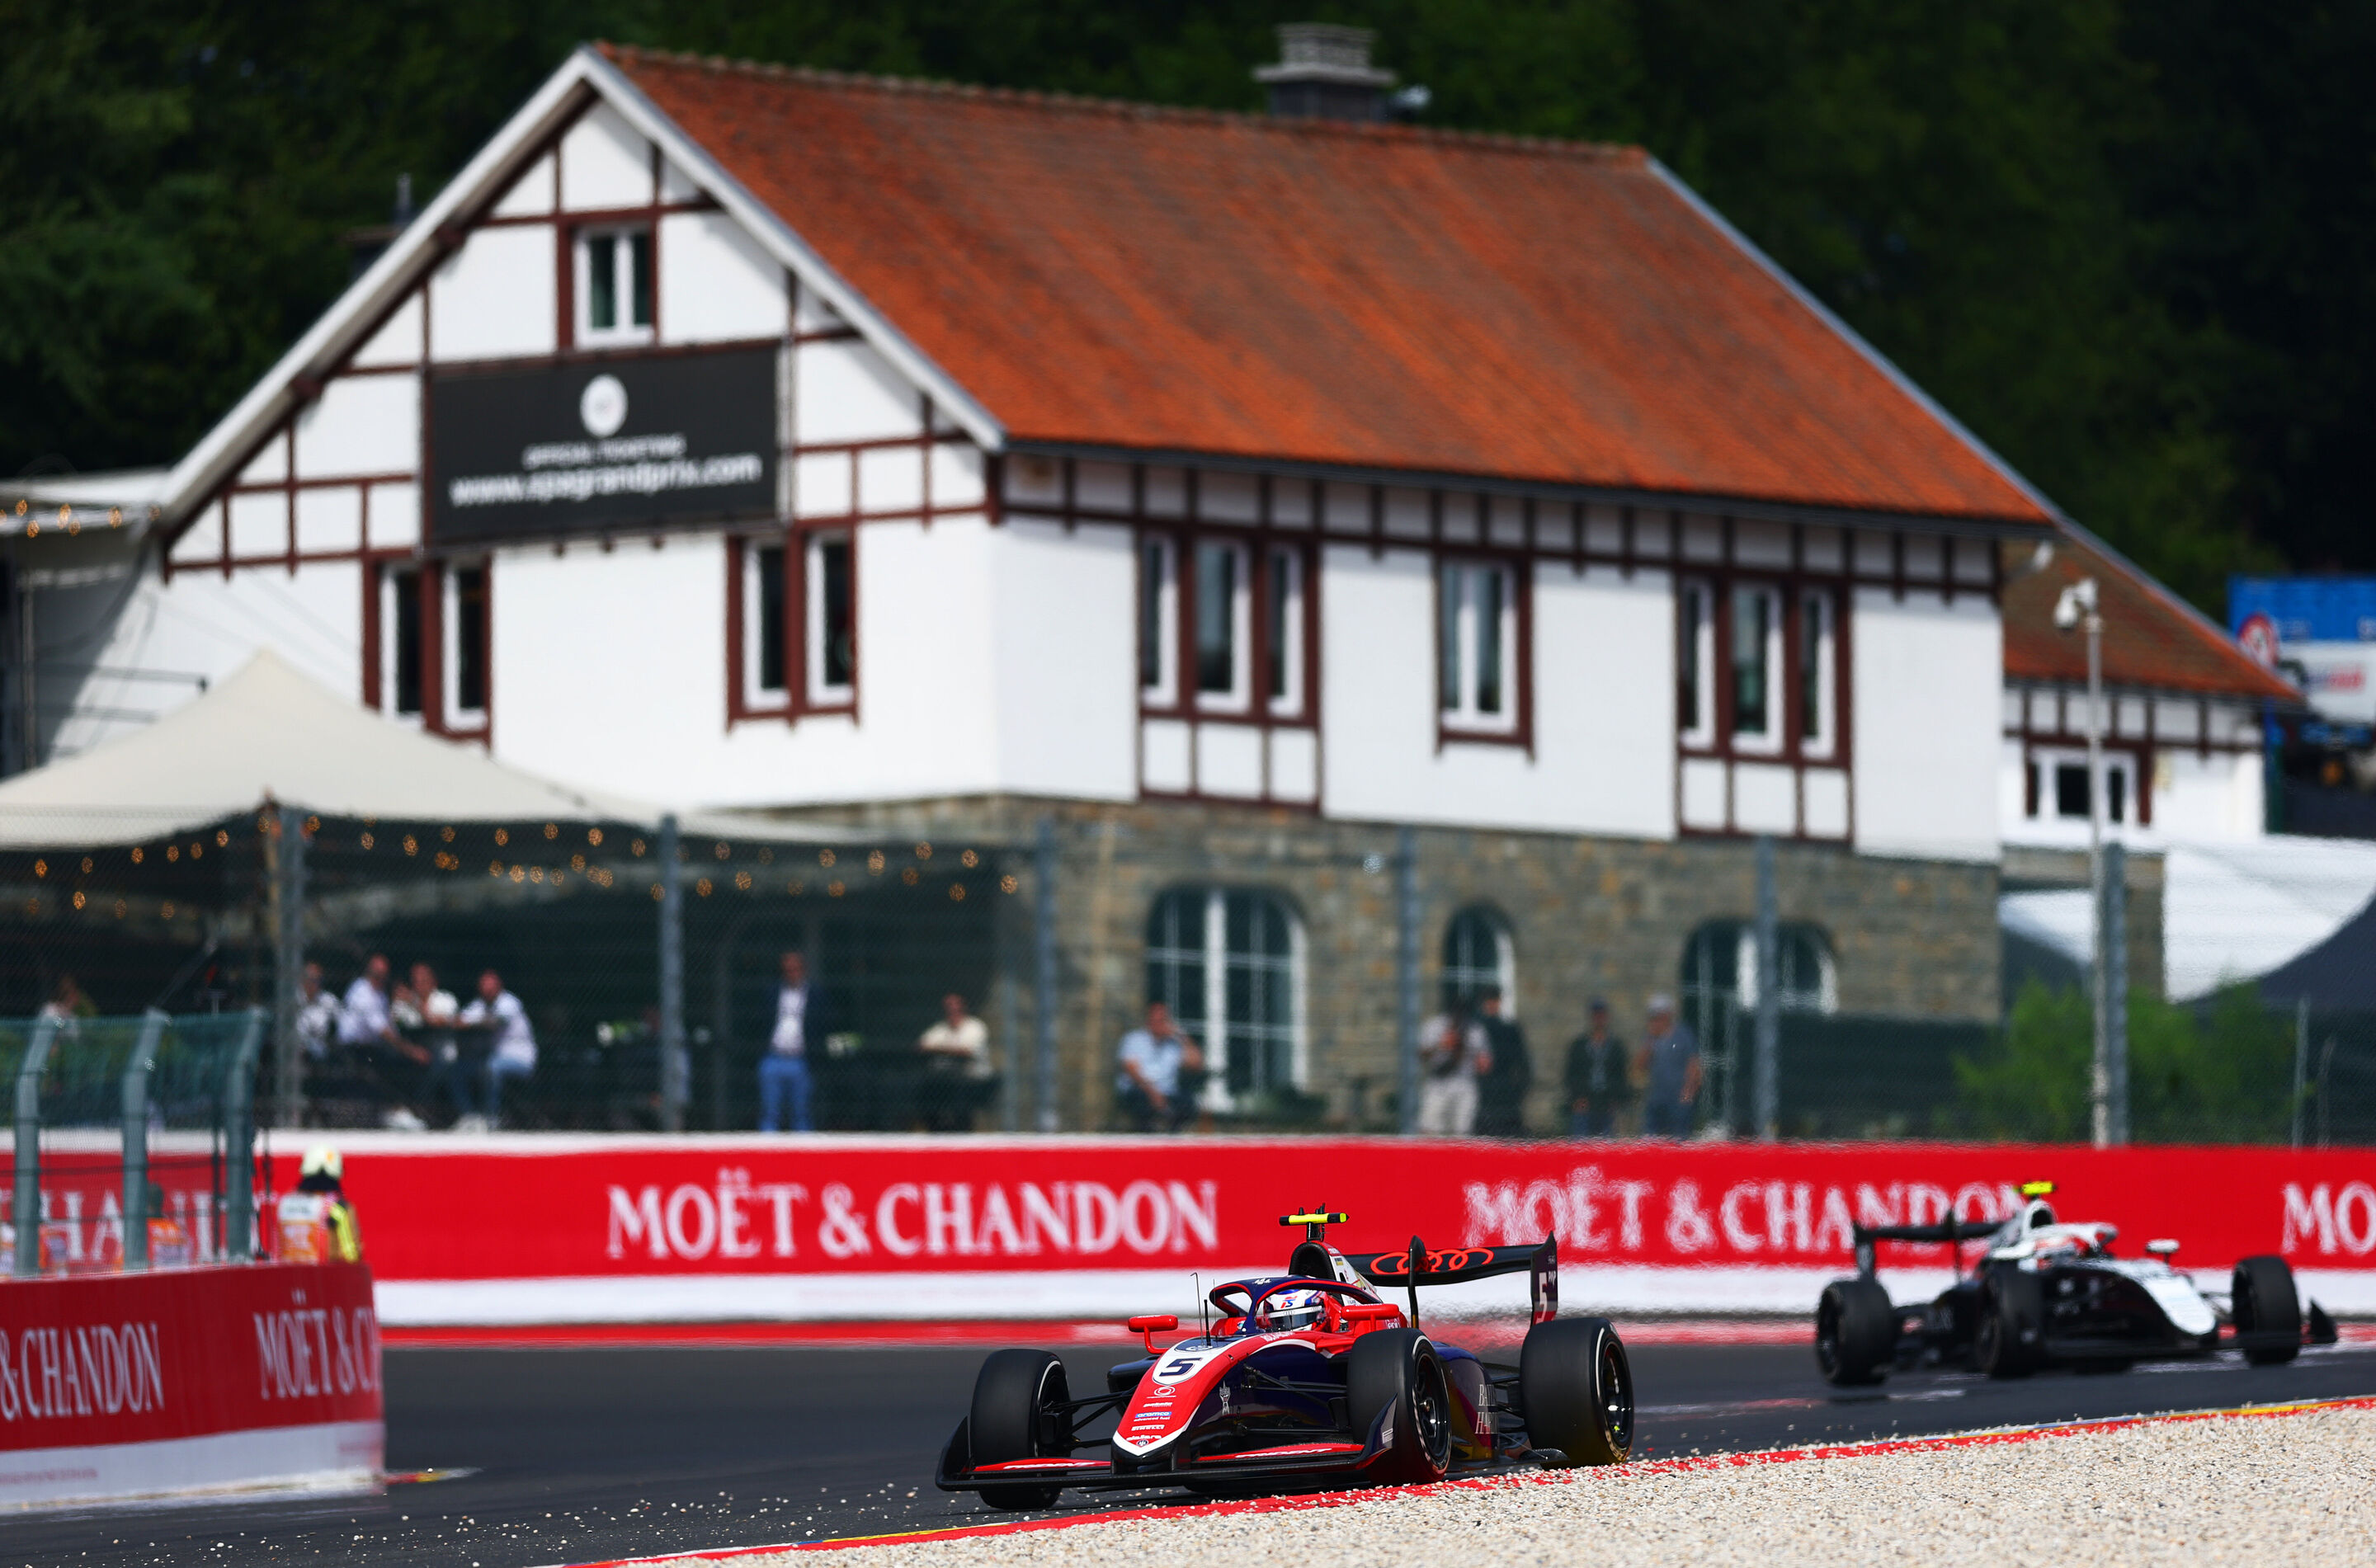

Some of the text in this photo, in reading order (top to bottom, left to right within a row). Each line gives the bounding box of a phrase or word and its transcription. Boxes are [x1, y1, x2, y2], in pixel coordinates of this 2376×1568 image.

[450, 453, 763, 507] www.spagrandprix.com
[606, 1165, 1219, 1260] MOËT & CHANDON
[1663, 1177, 1718, 1252] &
[0, 1321, 165, 1422] & CHANDON
[252, 1288, 332, 1401] MOËT
[332, 1305, 356, 1396] &
[1159, 1357, 1204, 1377] 5
